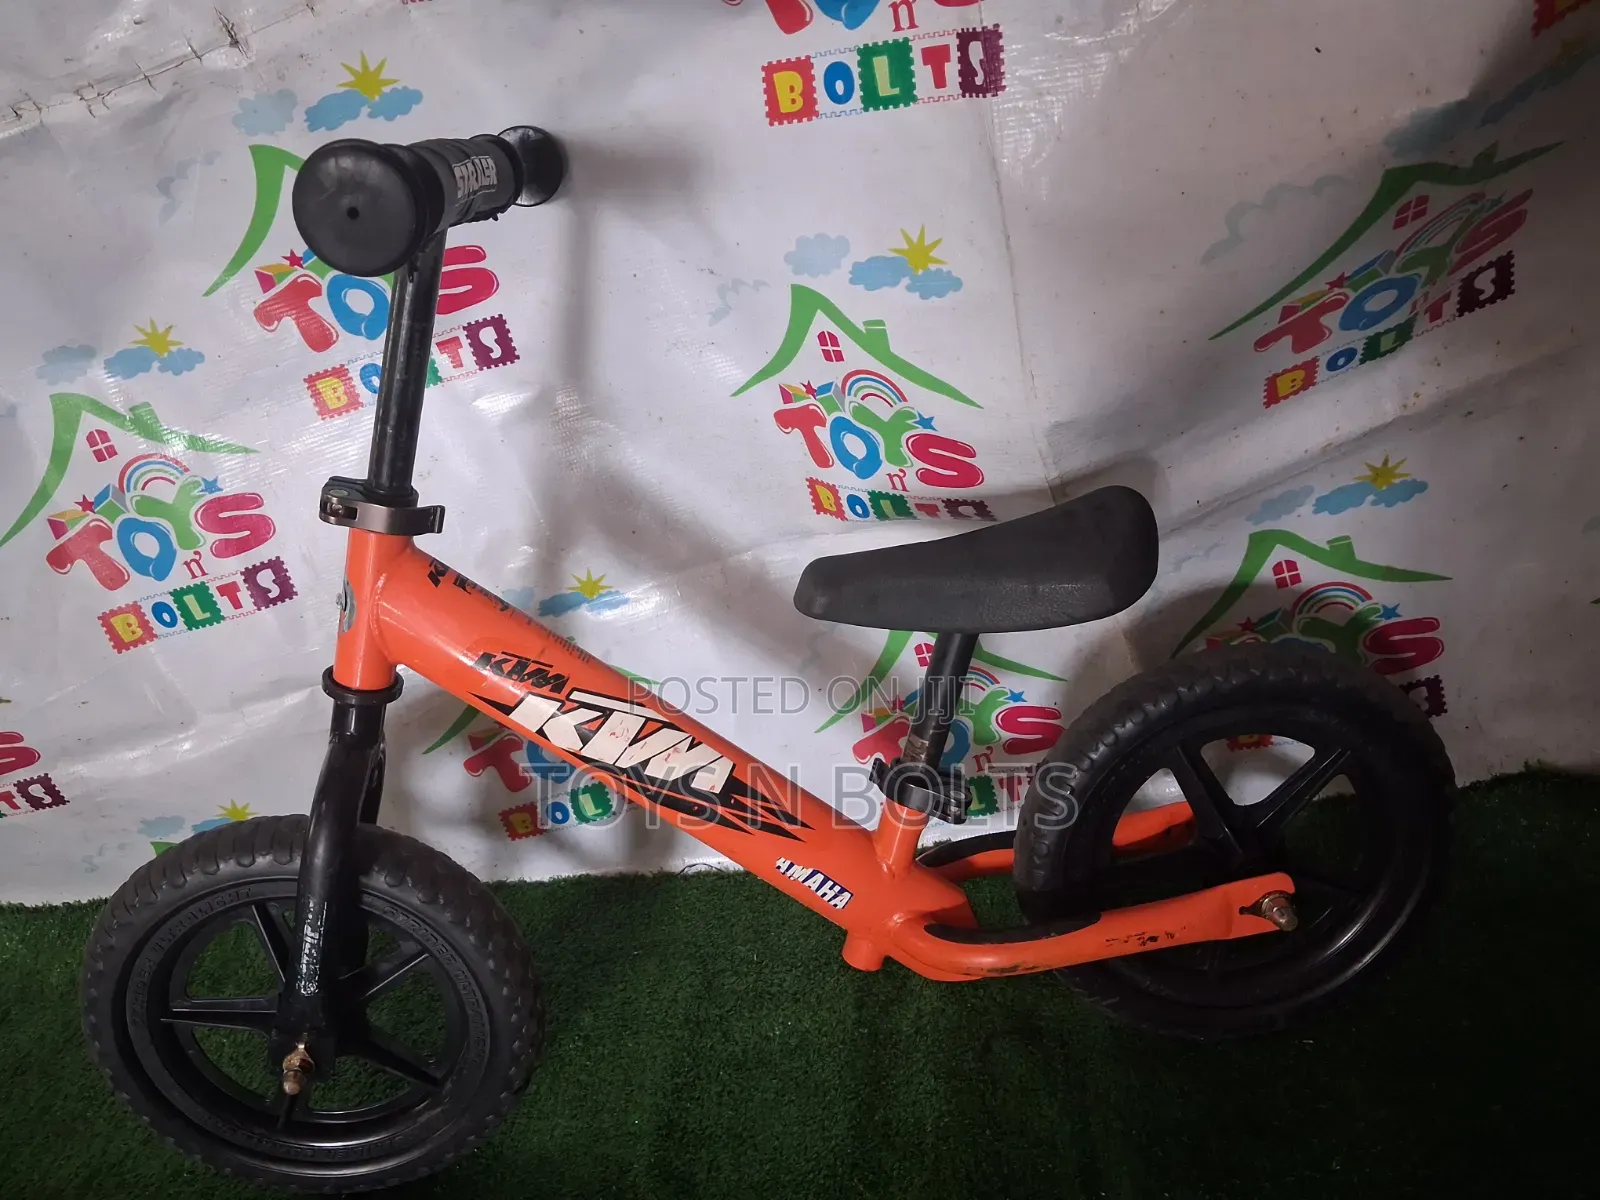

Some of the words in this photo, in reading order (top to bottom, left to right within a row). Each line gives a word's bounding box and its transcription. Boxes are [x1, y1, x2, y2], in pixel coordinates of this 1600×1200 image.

[768, 34, 994, 118] BOLTS
[253, 245, 500, 353] TOS
[1270, 260, 1504, 402] BOLTS
[310, 320, 510, 415] BOTS
[774, 400, 984, 488] TOYS
[46, 476, 277, 591] TOYS
[105, 562, 288, 648] BOLTS
[507, 690, 735, 795] KTM
